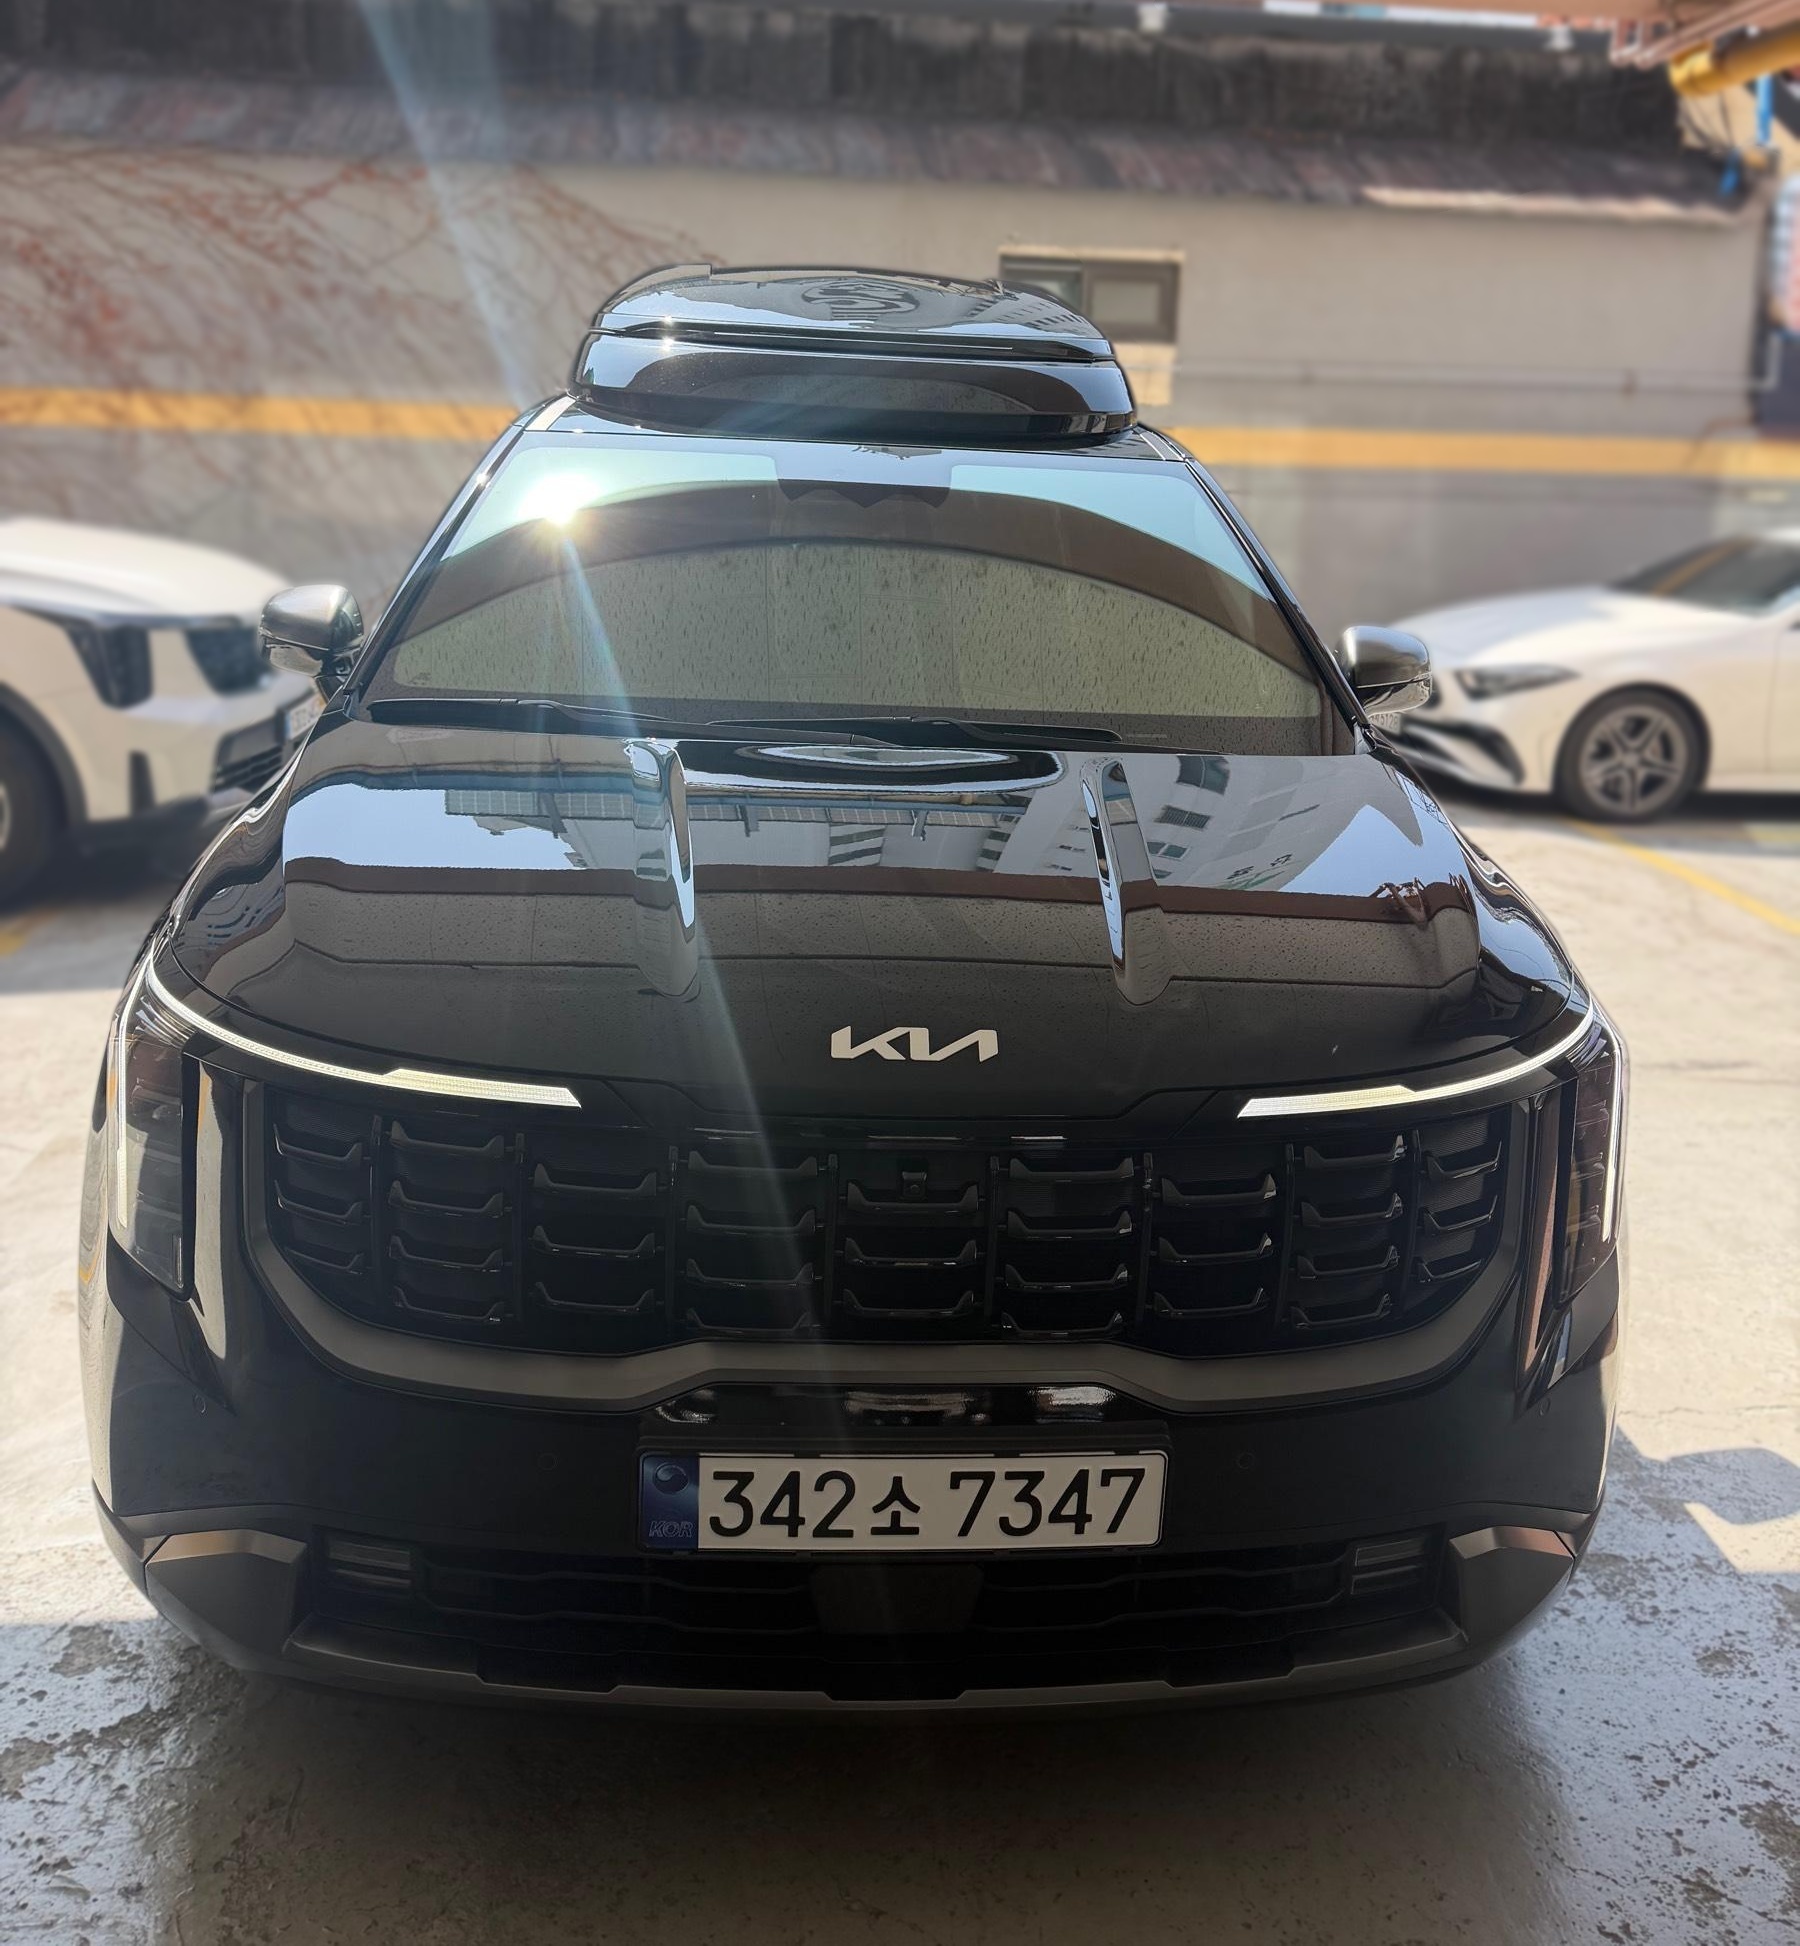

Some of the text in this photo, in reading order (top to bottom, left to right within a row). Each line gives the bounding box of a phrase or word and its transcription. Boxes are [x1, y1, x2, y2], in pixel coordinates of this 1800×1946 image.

[708, 1467, 1147, 1538] 342소 7347
[649, 1520, 694, 1538] KOR
